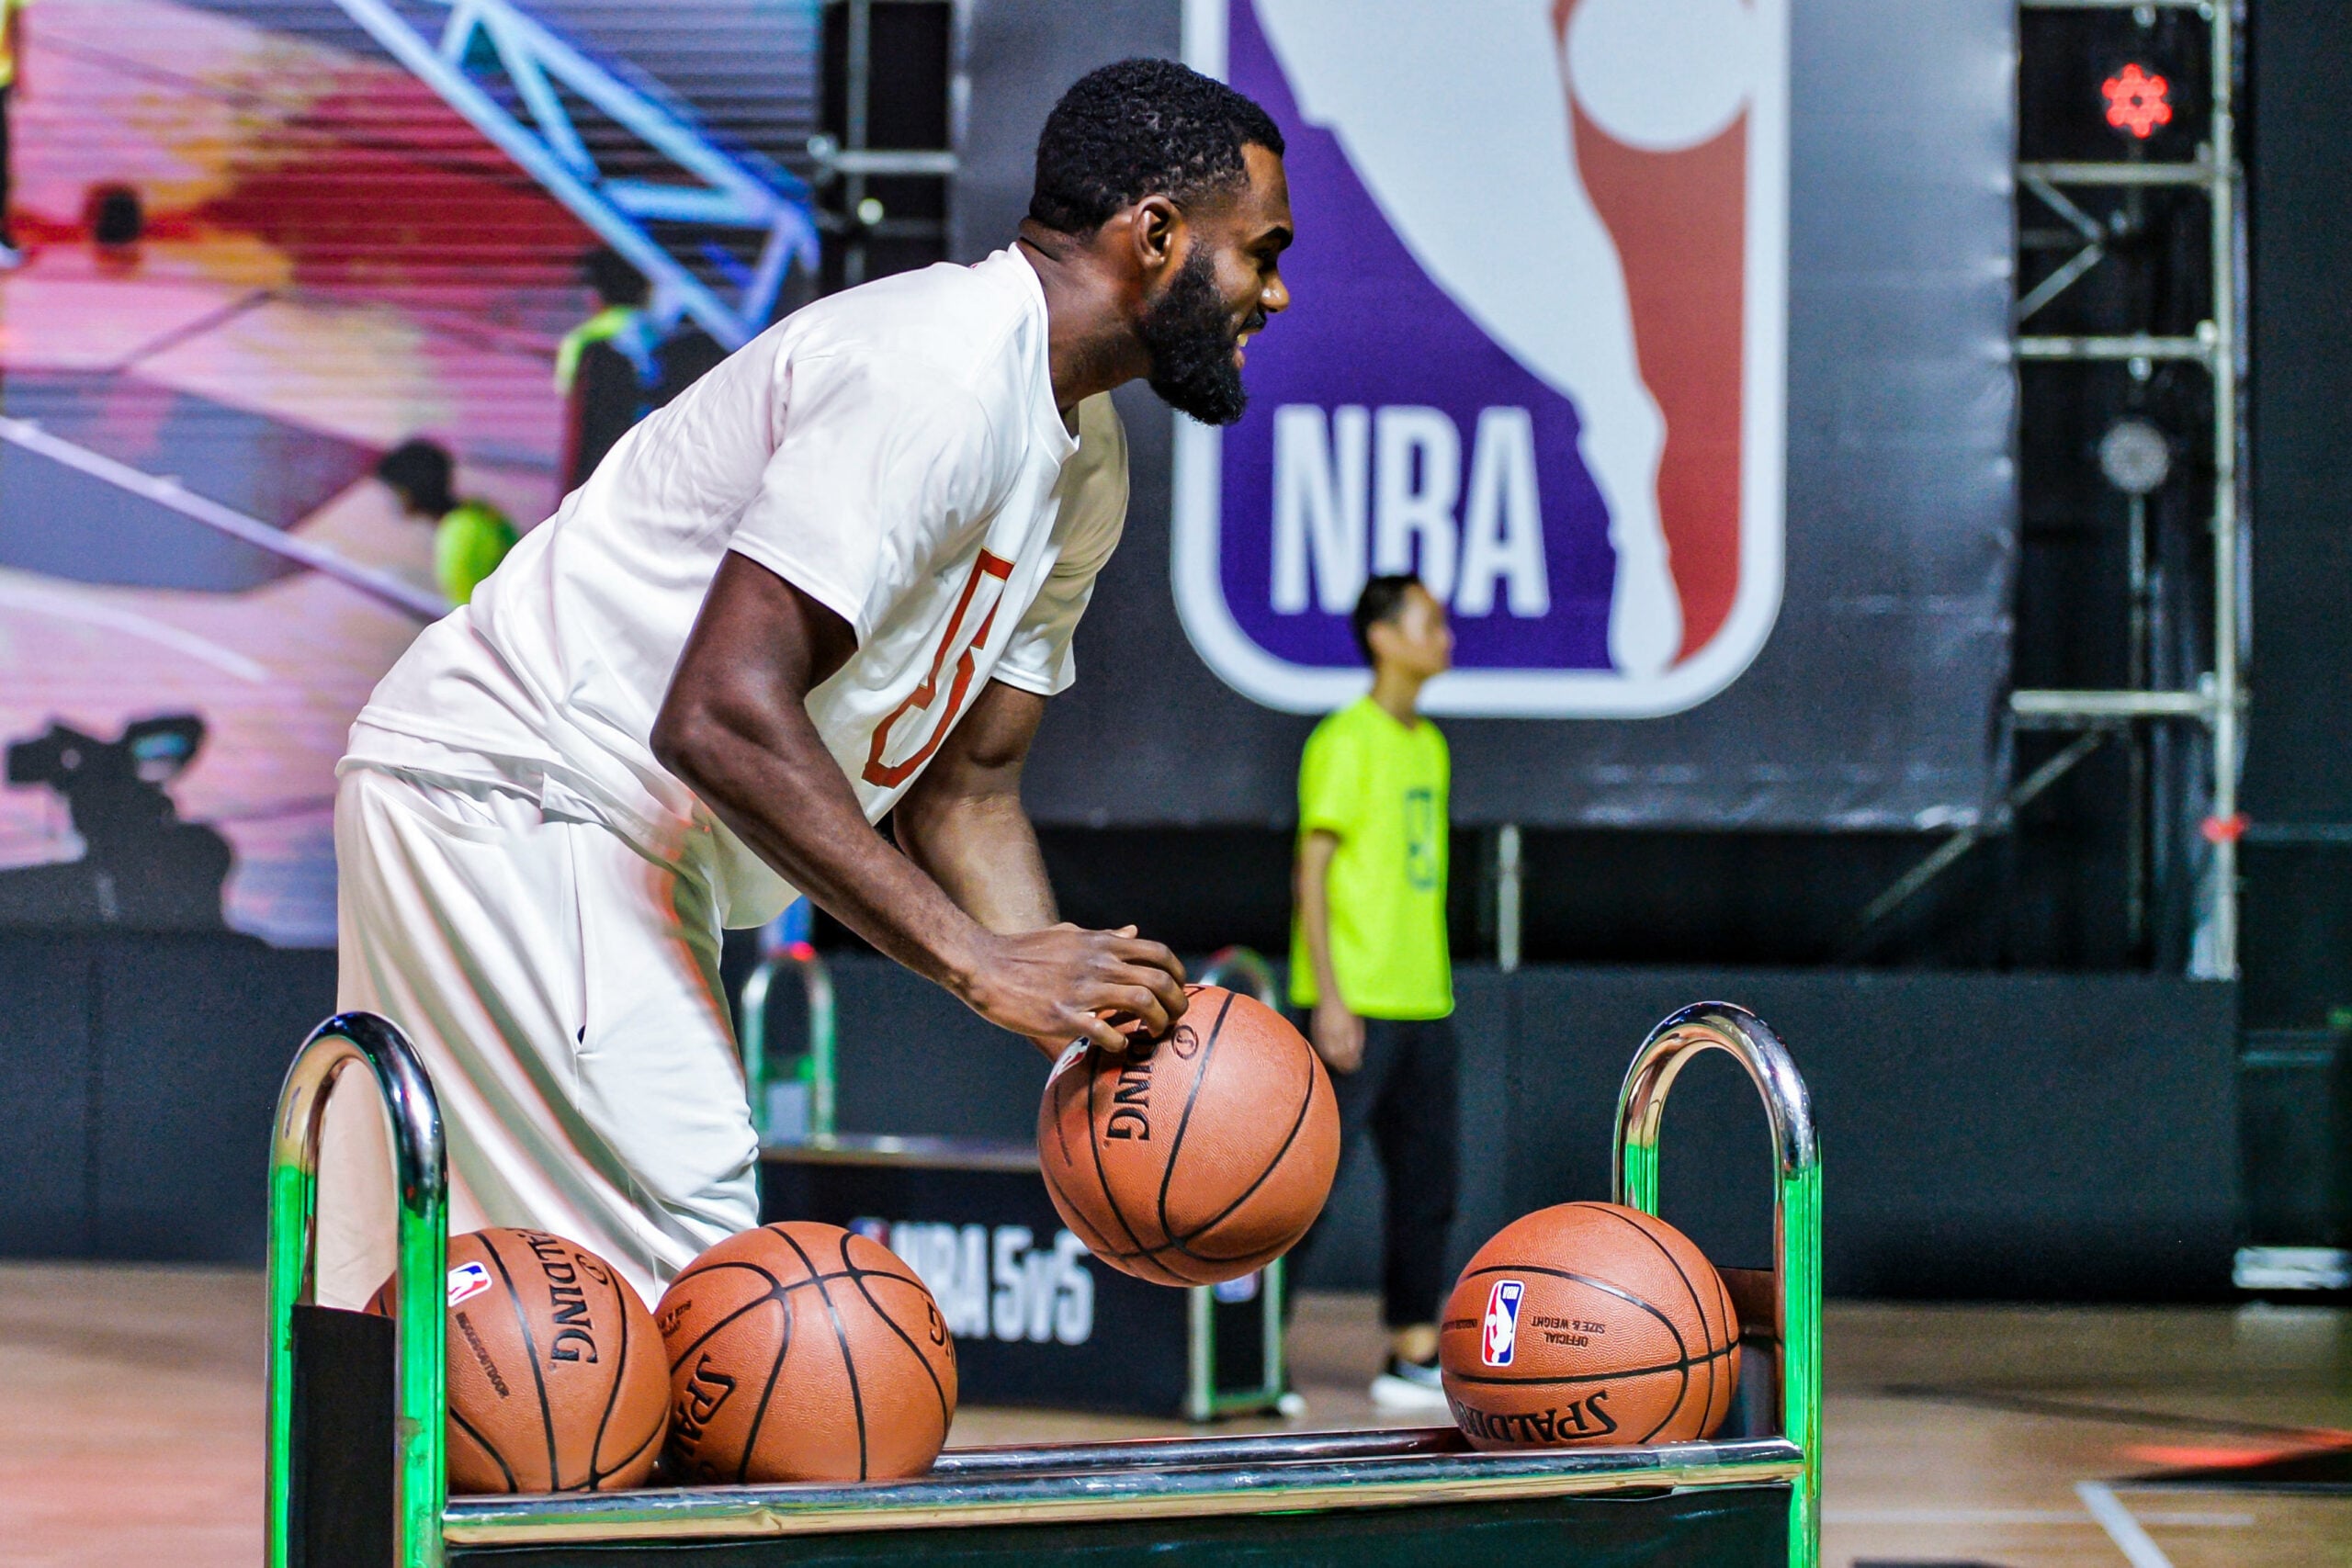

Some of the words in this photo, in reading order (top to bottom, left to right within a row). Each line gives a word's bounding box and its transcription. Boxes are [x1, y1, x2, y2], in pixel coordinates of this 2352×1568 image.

[1270, 404, 1551, 617] NBA
[1531, 1315, 1568, 1329] WEIGHT
[1581, 1321, 1606, 1334] SIZE
[1544, 1332, 1589, 1348] OFFICIAL
